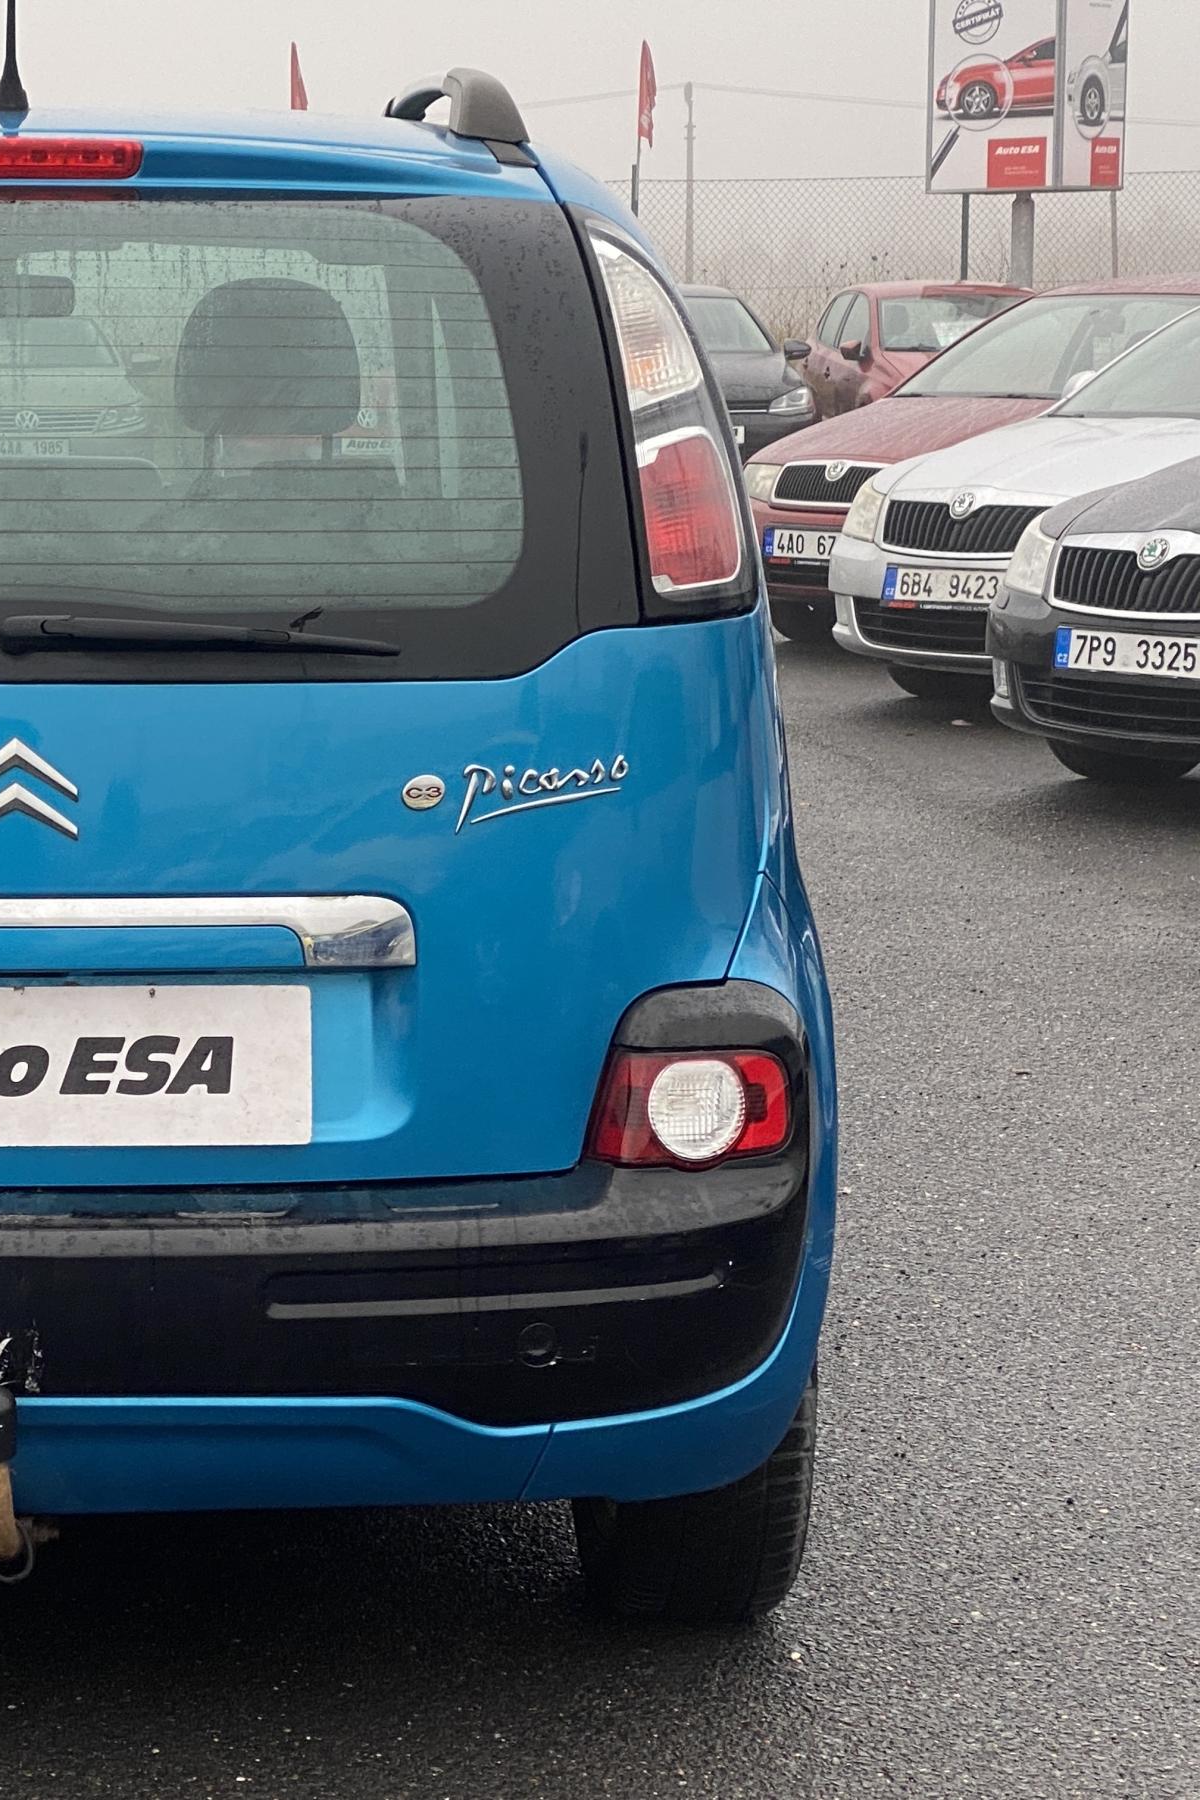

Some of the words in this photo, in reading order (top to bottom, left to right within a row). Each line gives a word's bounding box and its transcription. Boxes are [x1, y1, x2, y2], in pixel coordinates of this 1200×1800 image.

[995, 146, 1019, 155] Auto
[1020, 145, 1040, 154] ESA
[900, 572, 933, 597] 6B4
[948, 574, 1000, 600] 9423
[1057, 653, 1068, 662] CZ
[1073, 634, 1117, 666] 7P9
[1135, 639, 1198, 673] 3325
[454, 753, 629, 834] Picasso
[58, 1035, 234, 1096] ESA
